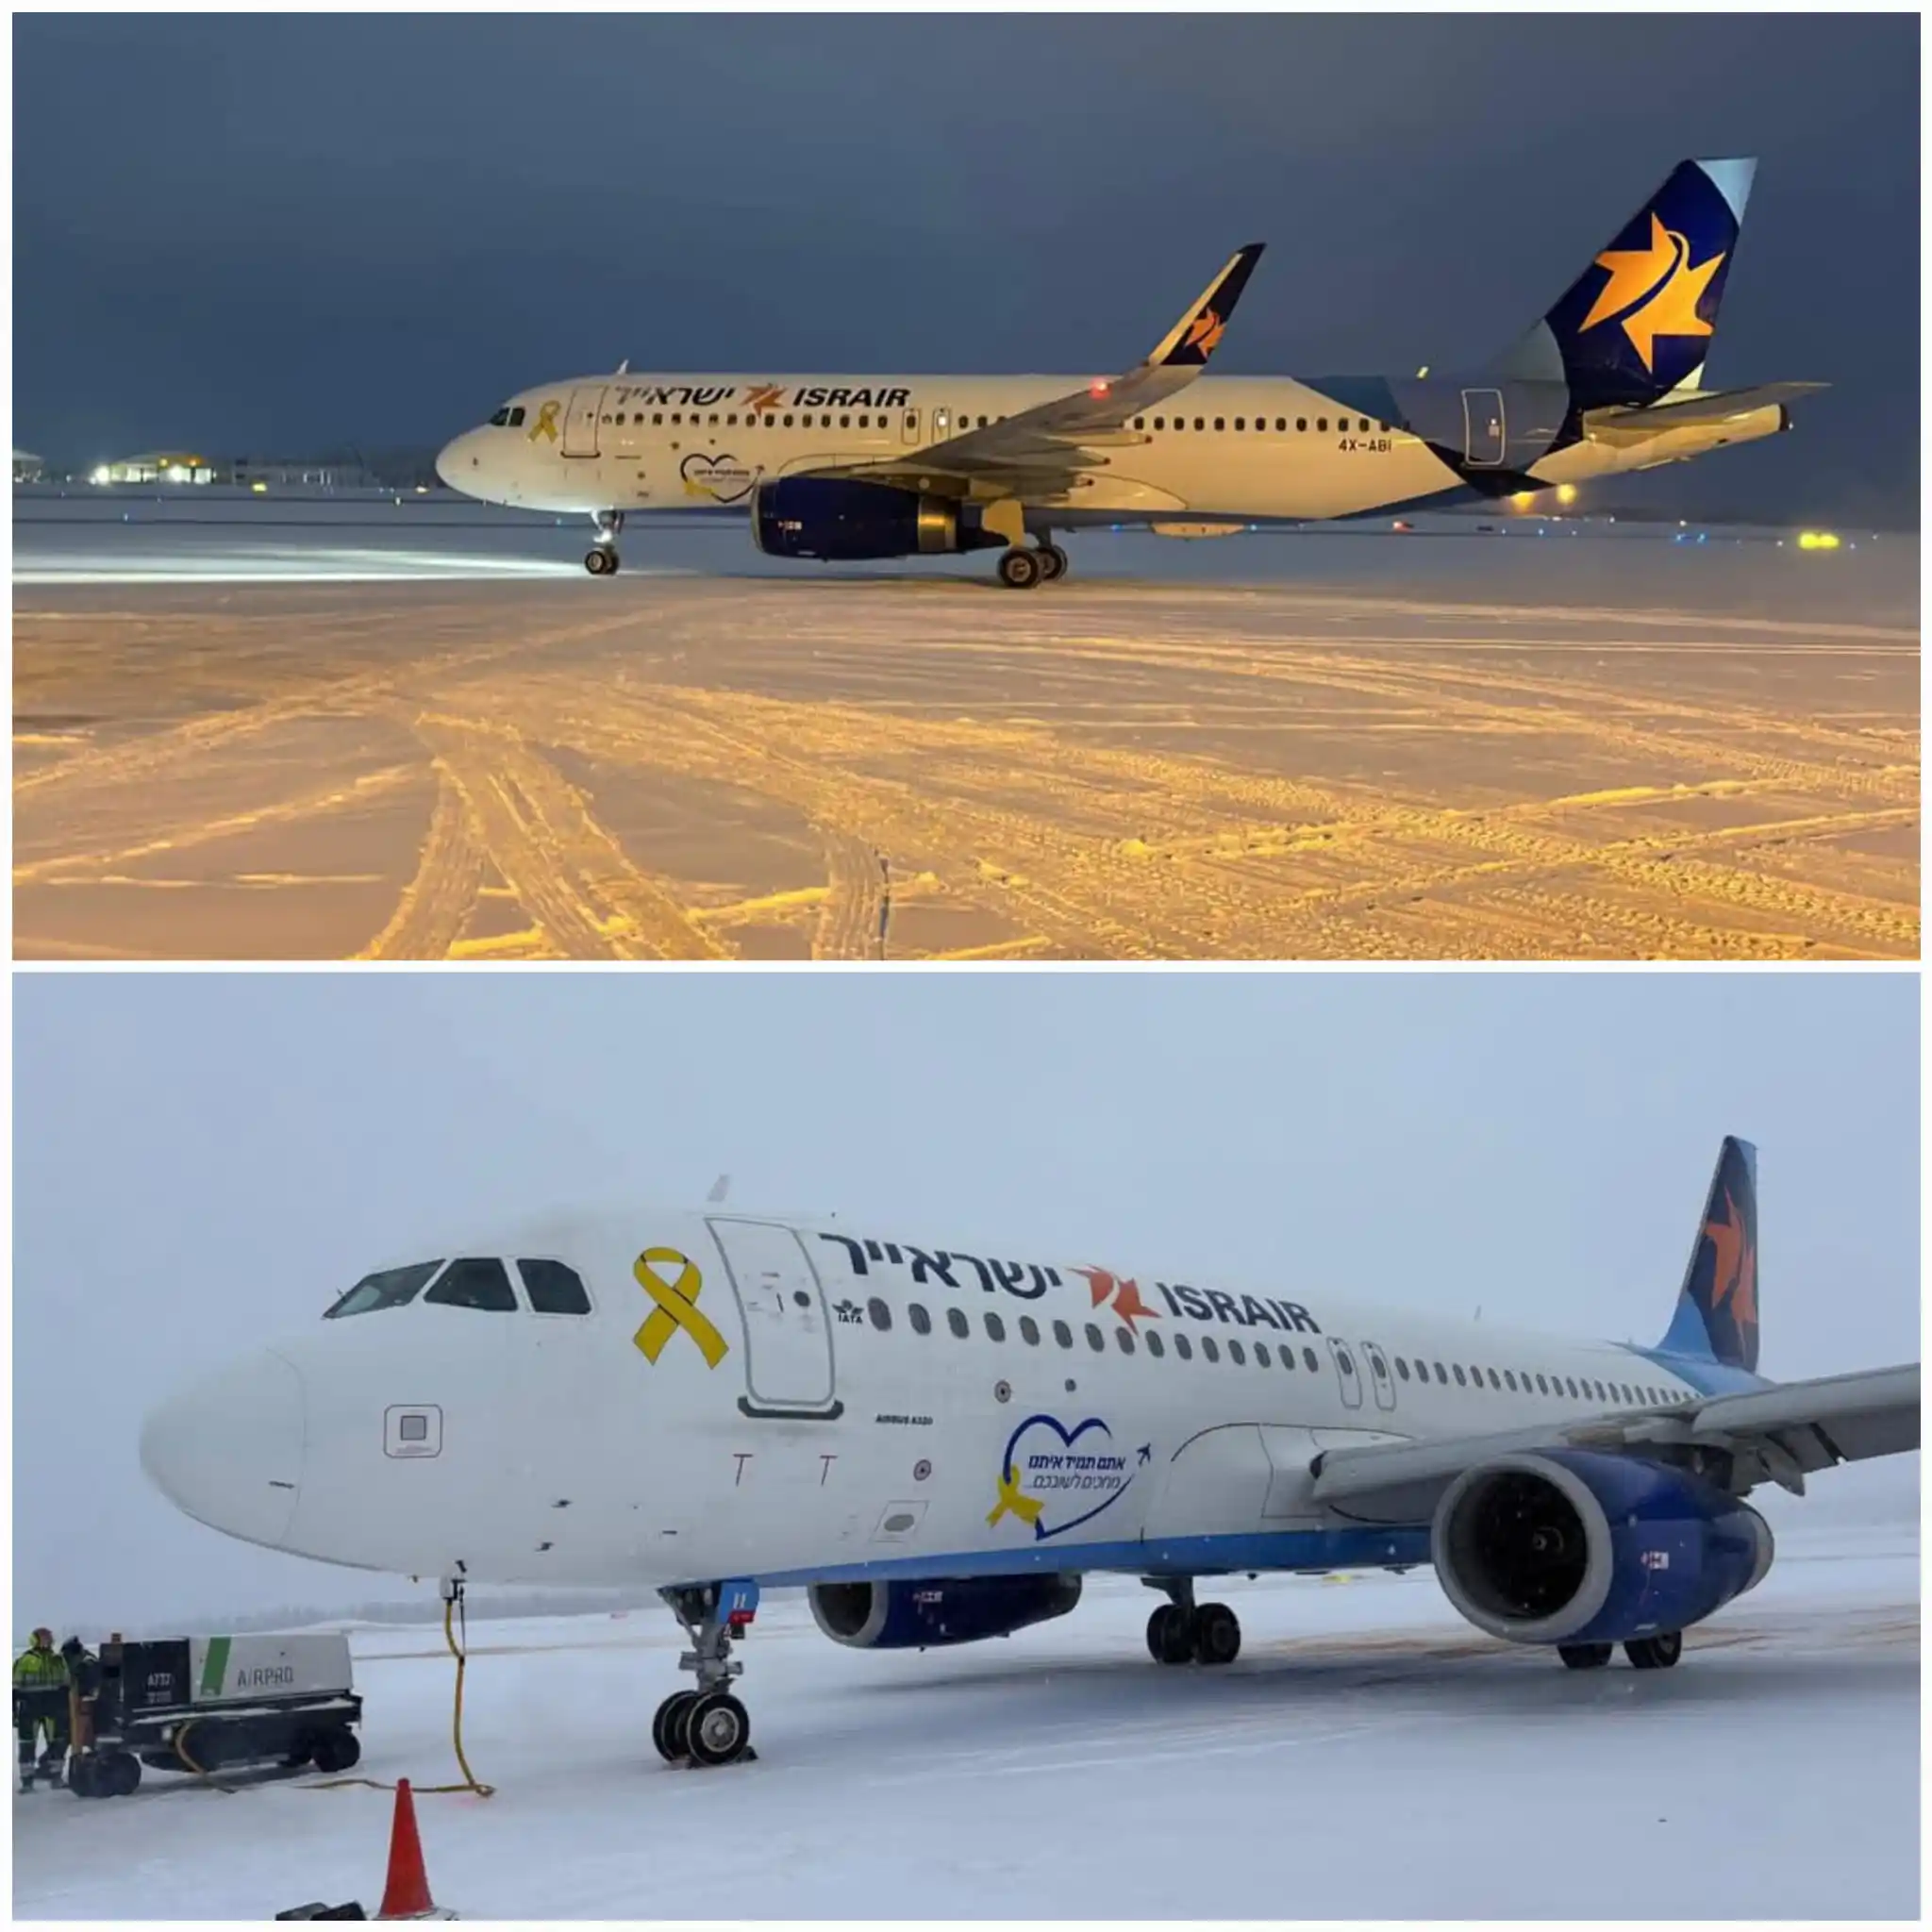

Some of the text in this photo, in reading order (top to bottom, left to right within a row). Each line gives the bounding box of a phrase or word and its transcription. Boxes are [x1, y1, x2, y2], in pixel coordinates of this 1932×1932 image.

[615, 385, 736, 406] ישראייר
[792, 387, 910, 408] ISRAIR
[1339, 438, 1392, 453] 4X-ABI
[818, 1232, 1062, 1299] ישראייר
[839, 1313, 863, 1324] IATA
[1155, 1282, 1322, 1334] ISRAIR
